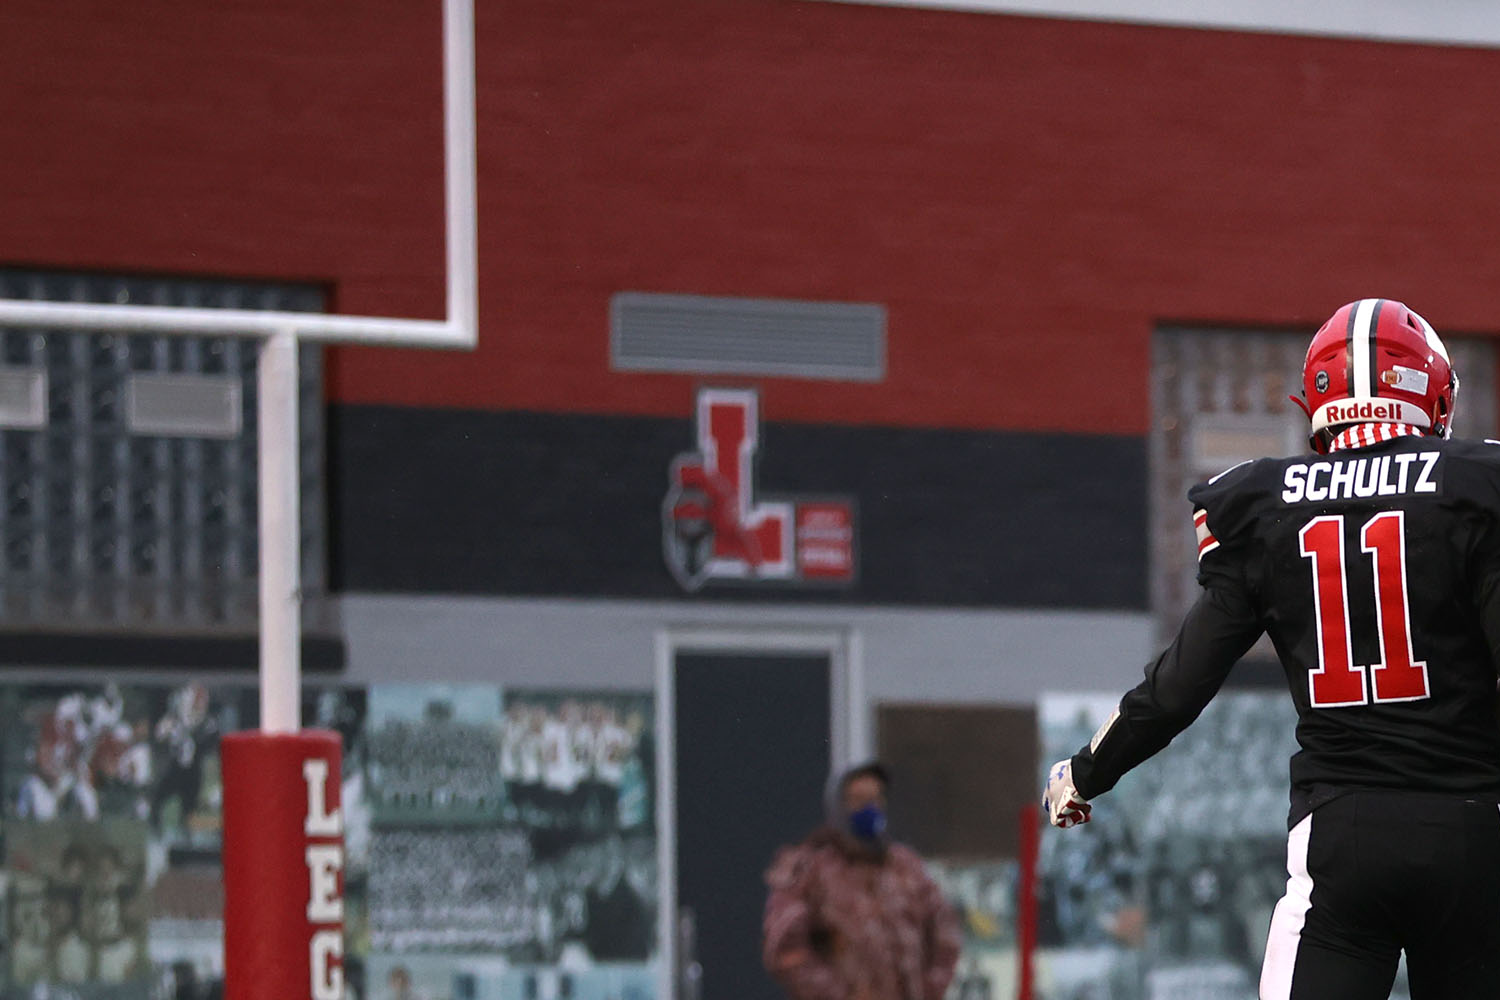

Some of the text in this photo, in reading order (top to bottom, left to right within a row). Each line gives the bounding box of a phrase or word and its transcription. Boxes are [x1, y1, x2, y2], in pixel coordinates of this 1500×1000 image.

[1326, 402, 1402, 423] Riddell
[1282, 451, 1440, 504] SCHULTZ
[1298, 510, 1431, 708] 11
